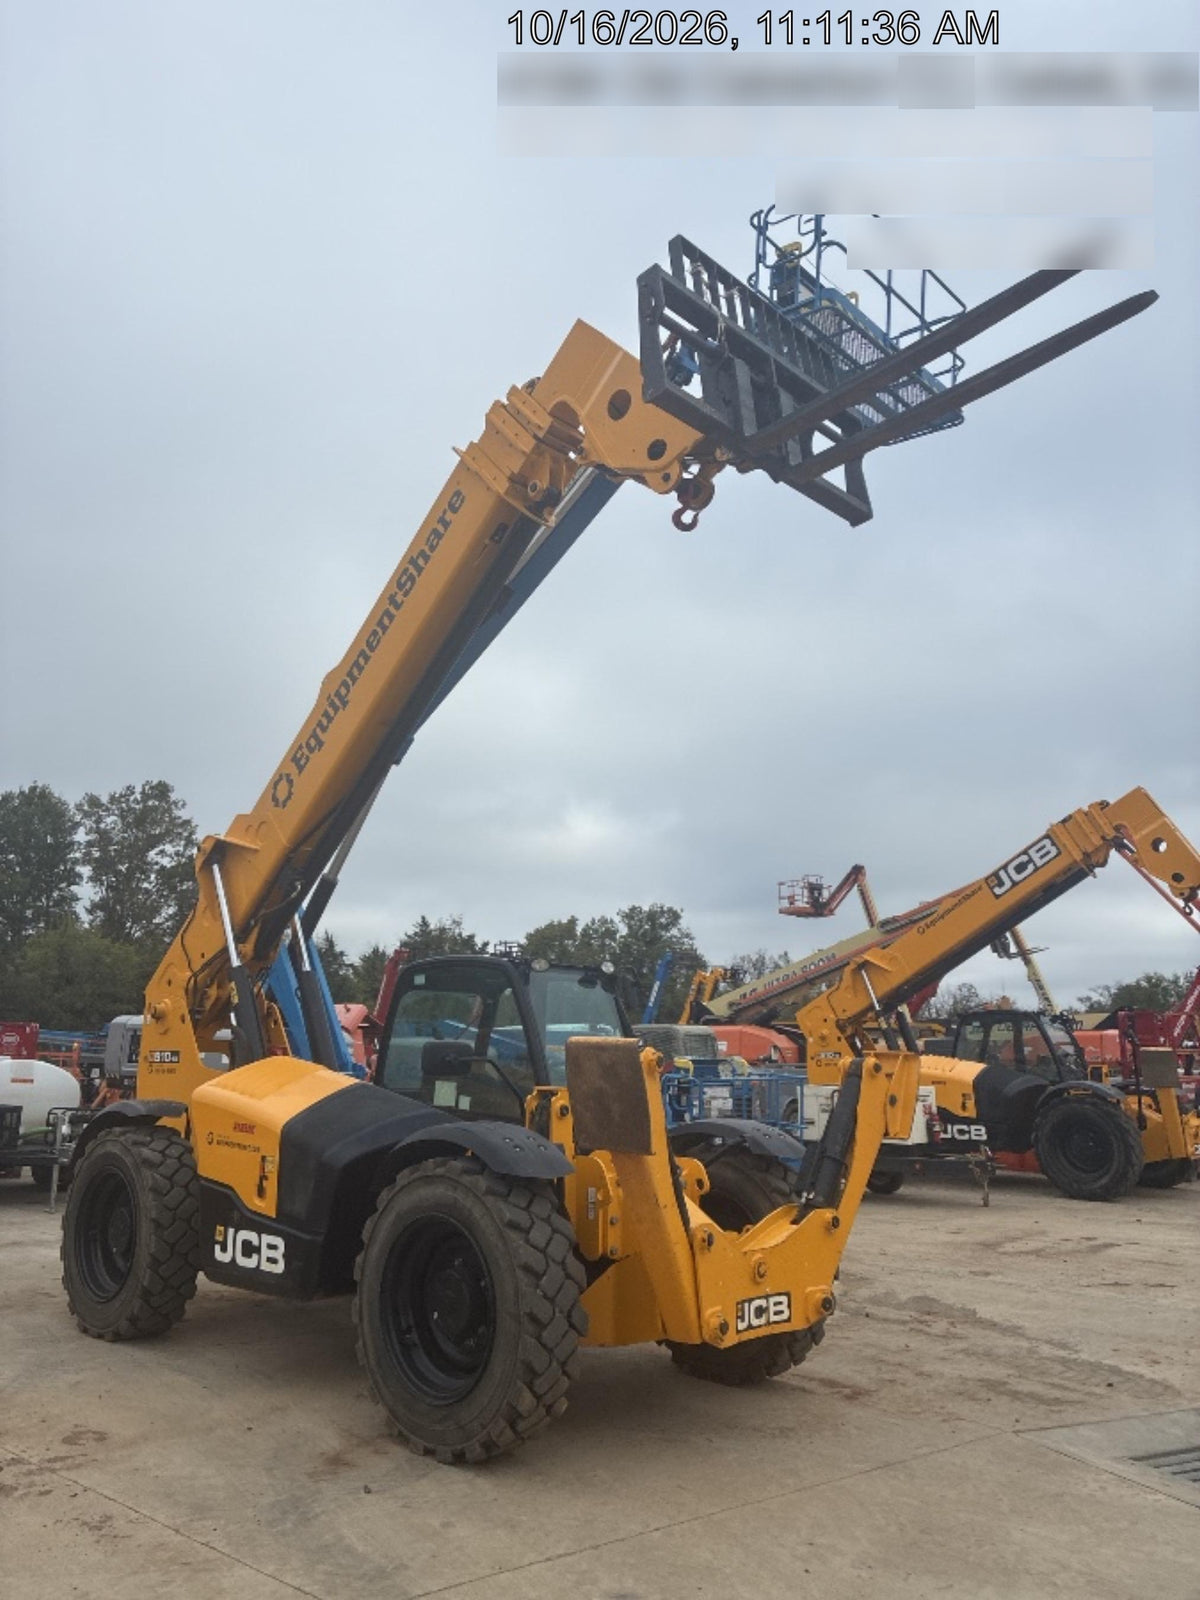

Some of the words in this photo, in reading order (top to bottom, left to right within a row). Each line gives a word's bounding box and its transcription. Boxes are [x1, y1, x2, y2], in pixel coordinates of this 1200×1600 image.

[291, 487, 466, 777] EquipmentShare
[992, 837, 1060, 896] JCB
[939, 1123, 988, 1141] JCB
[214, 1226, 286, 1274] JCB
[737, 1294, 791, 1331] JCB
